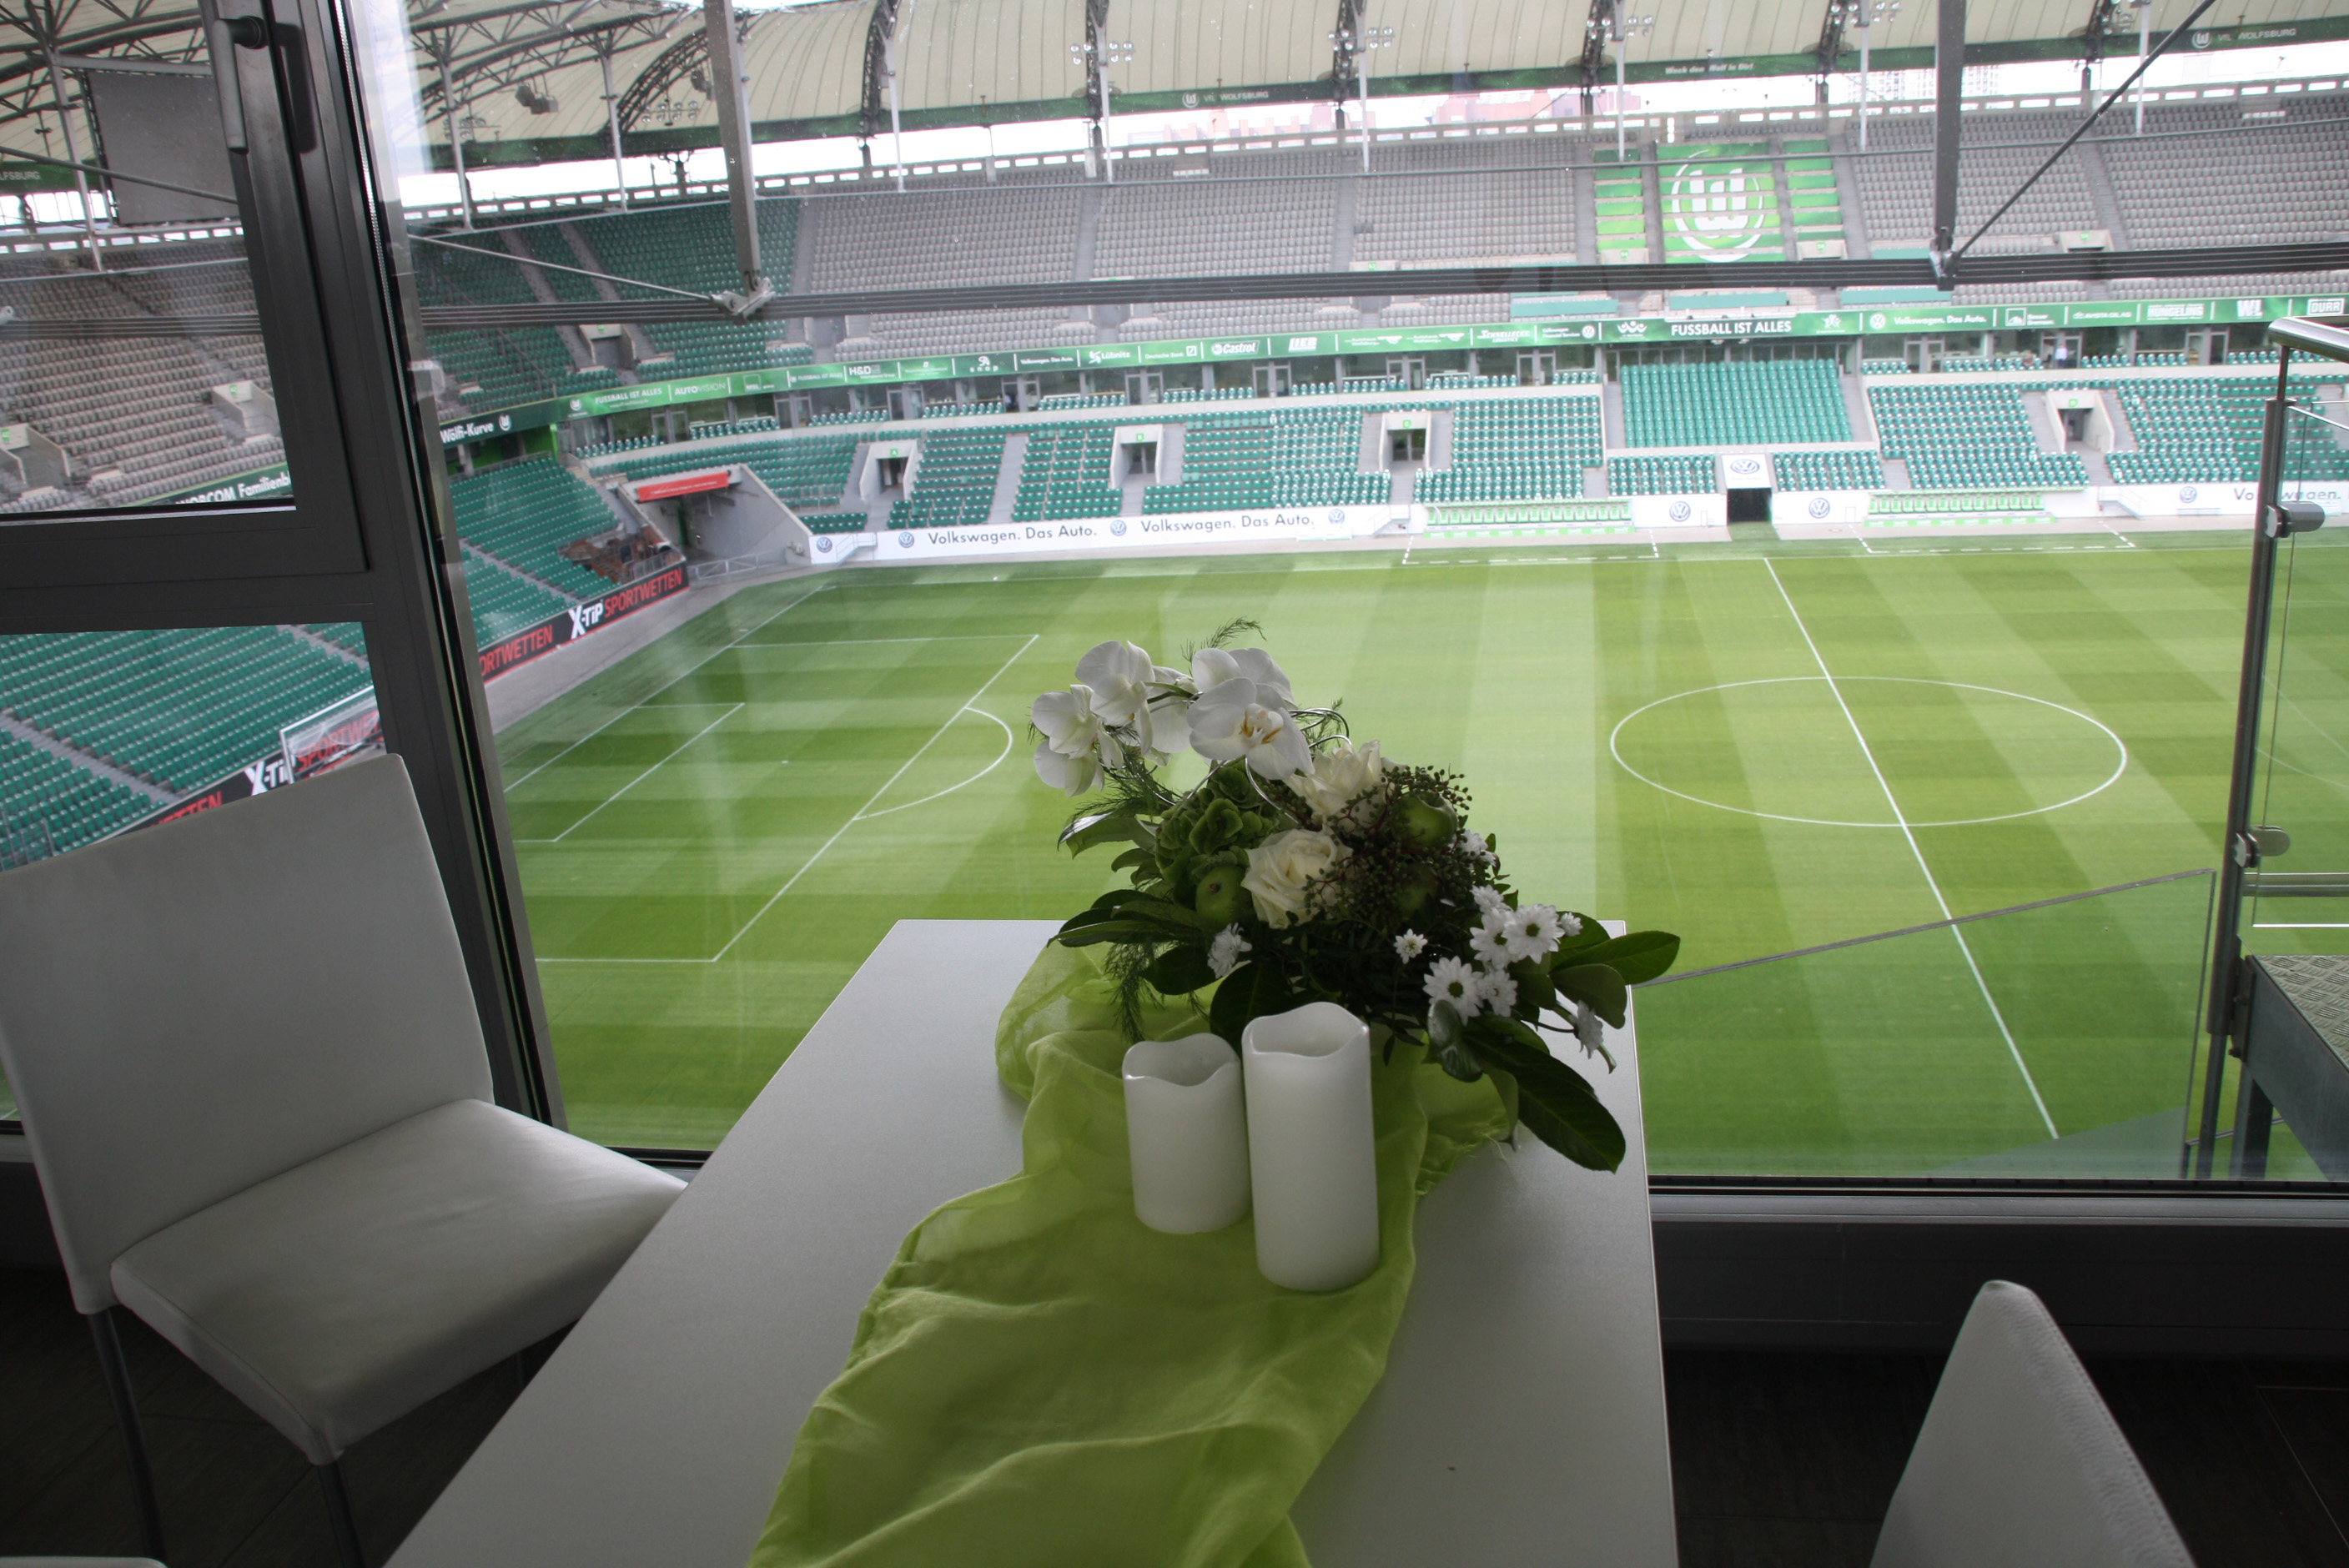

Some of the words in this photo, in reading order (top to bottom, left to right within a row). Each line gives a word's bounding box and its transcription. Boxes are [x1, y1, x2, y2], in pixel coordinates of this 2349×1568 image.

[1670, 322, 1733, 337] FUSSBALL
[1734, 321, 1753, 334] IST
[1755, 319, 1792, 334] ALLES
[1223, 342, 1257, 354] Castrol
[849, 365, 872, 375] H&D
[596, 393, 629, 404] FUSSBALL
[629, 390, 639, 399] IST
[641, 387, 662, 397] ALLES
[674, 382, 726, 395] AUTOVISION
[2234, 487, 2341, 501] Vowagen.
[1140, 519, 1236, 534] Volkswagen.
[1241, 515, 1270, 528] Das
[1275, 513, 1315, 525] Auto.
[928, 528, 1021, 545] Volkswagen.
[1025, 527, 1053, 540] Das
[1059, 525, 1098, 537] Auto.
[604, 567, 682, 619] SPORTWETTEN
